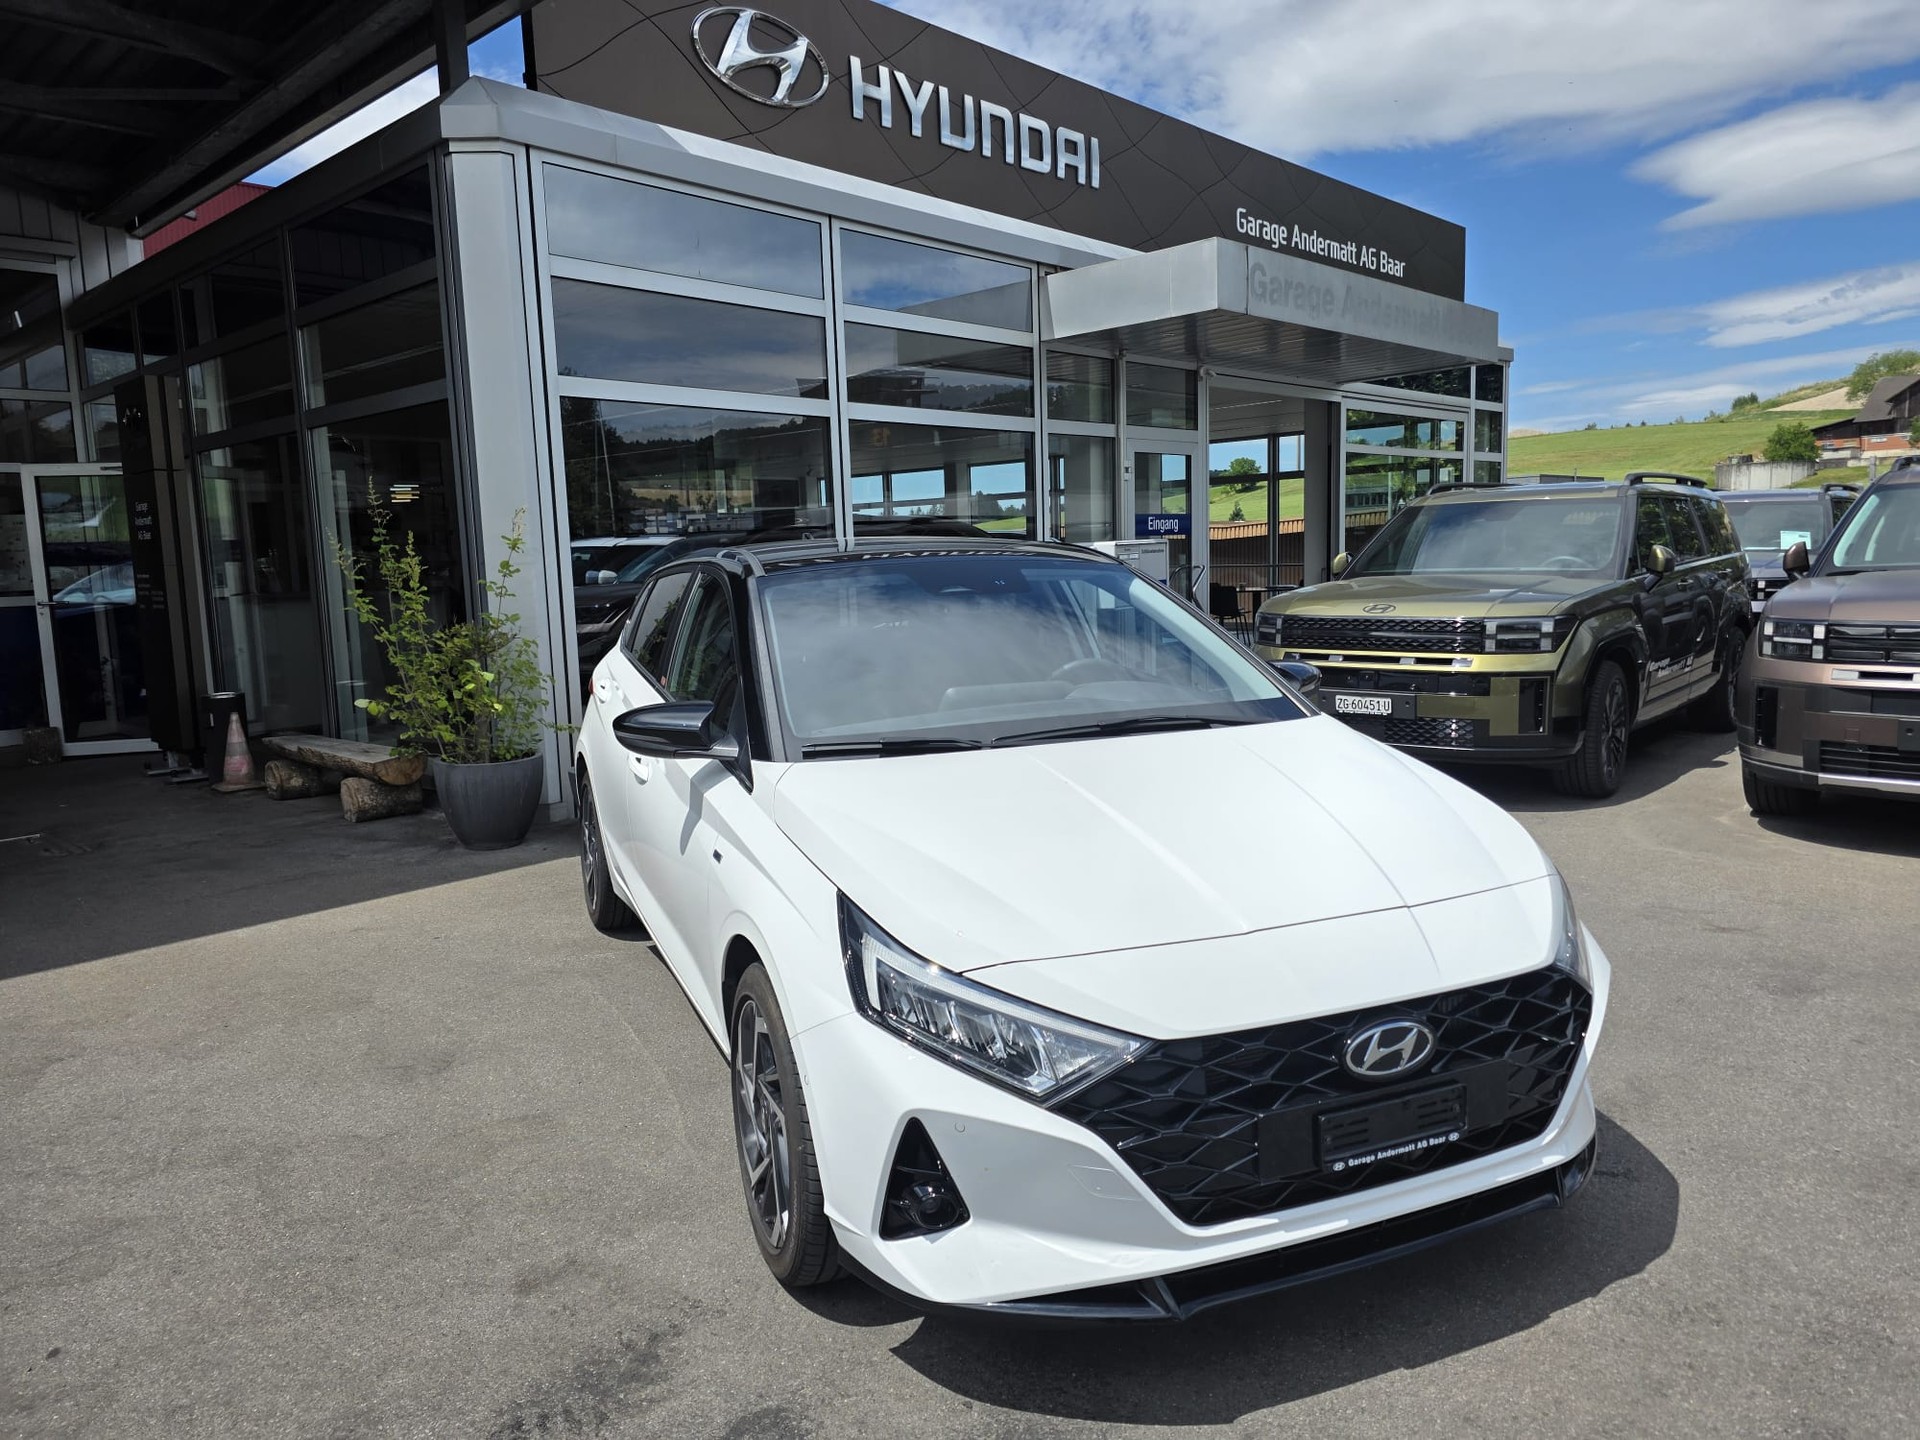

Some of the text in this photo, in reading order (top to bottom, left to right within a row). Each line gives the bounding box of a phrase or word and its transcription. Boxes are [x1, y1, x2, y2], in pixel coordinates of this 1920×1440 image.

[850, 55, 1100, 189] HYUNDAI
[1236, 207, 1406, 278] Garage Andermatt AG Baar
[1148, 516, 1179, 532] Eingang
[1348, 1155, 1375, 1166] Garage
[1377, 1143, 1415, 1159] Andermatt
[1416, 1141, 1428, 1150] AG
